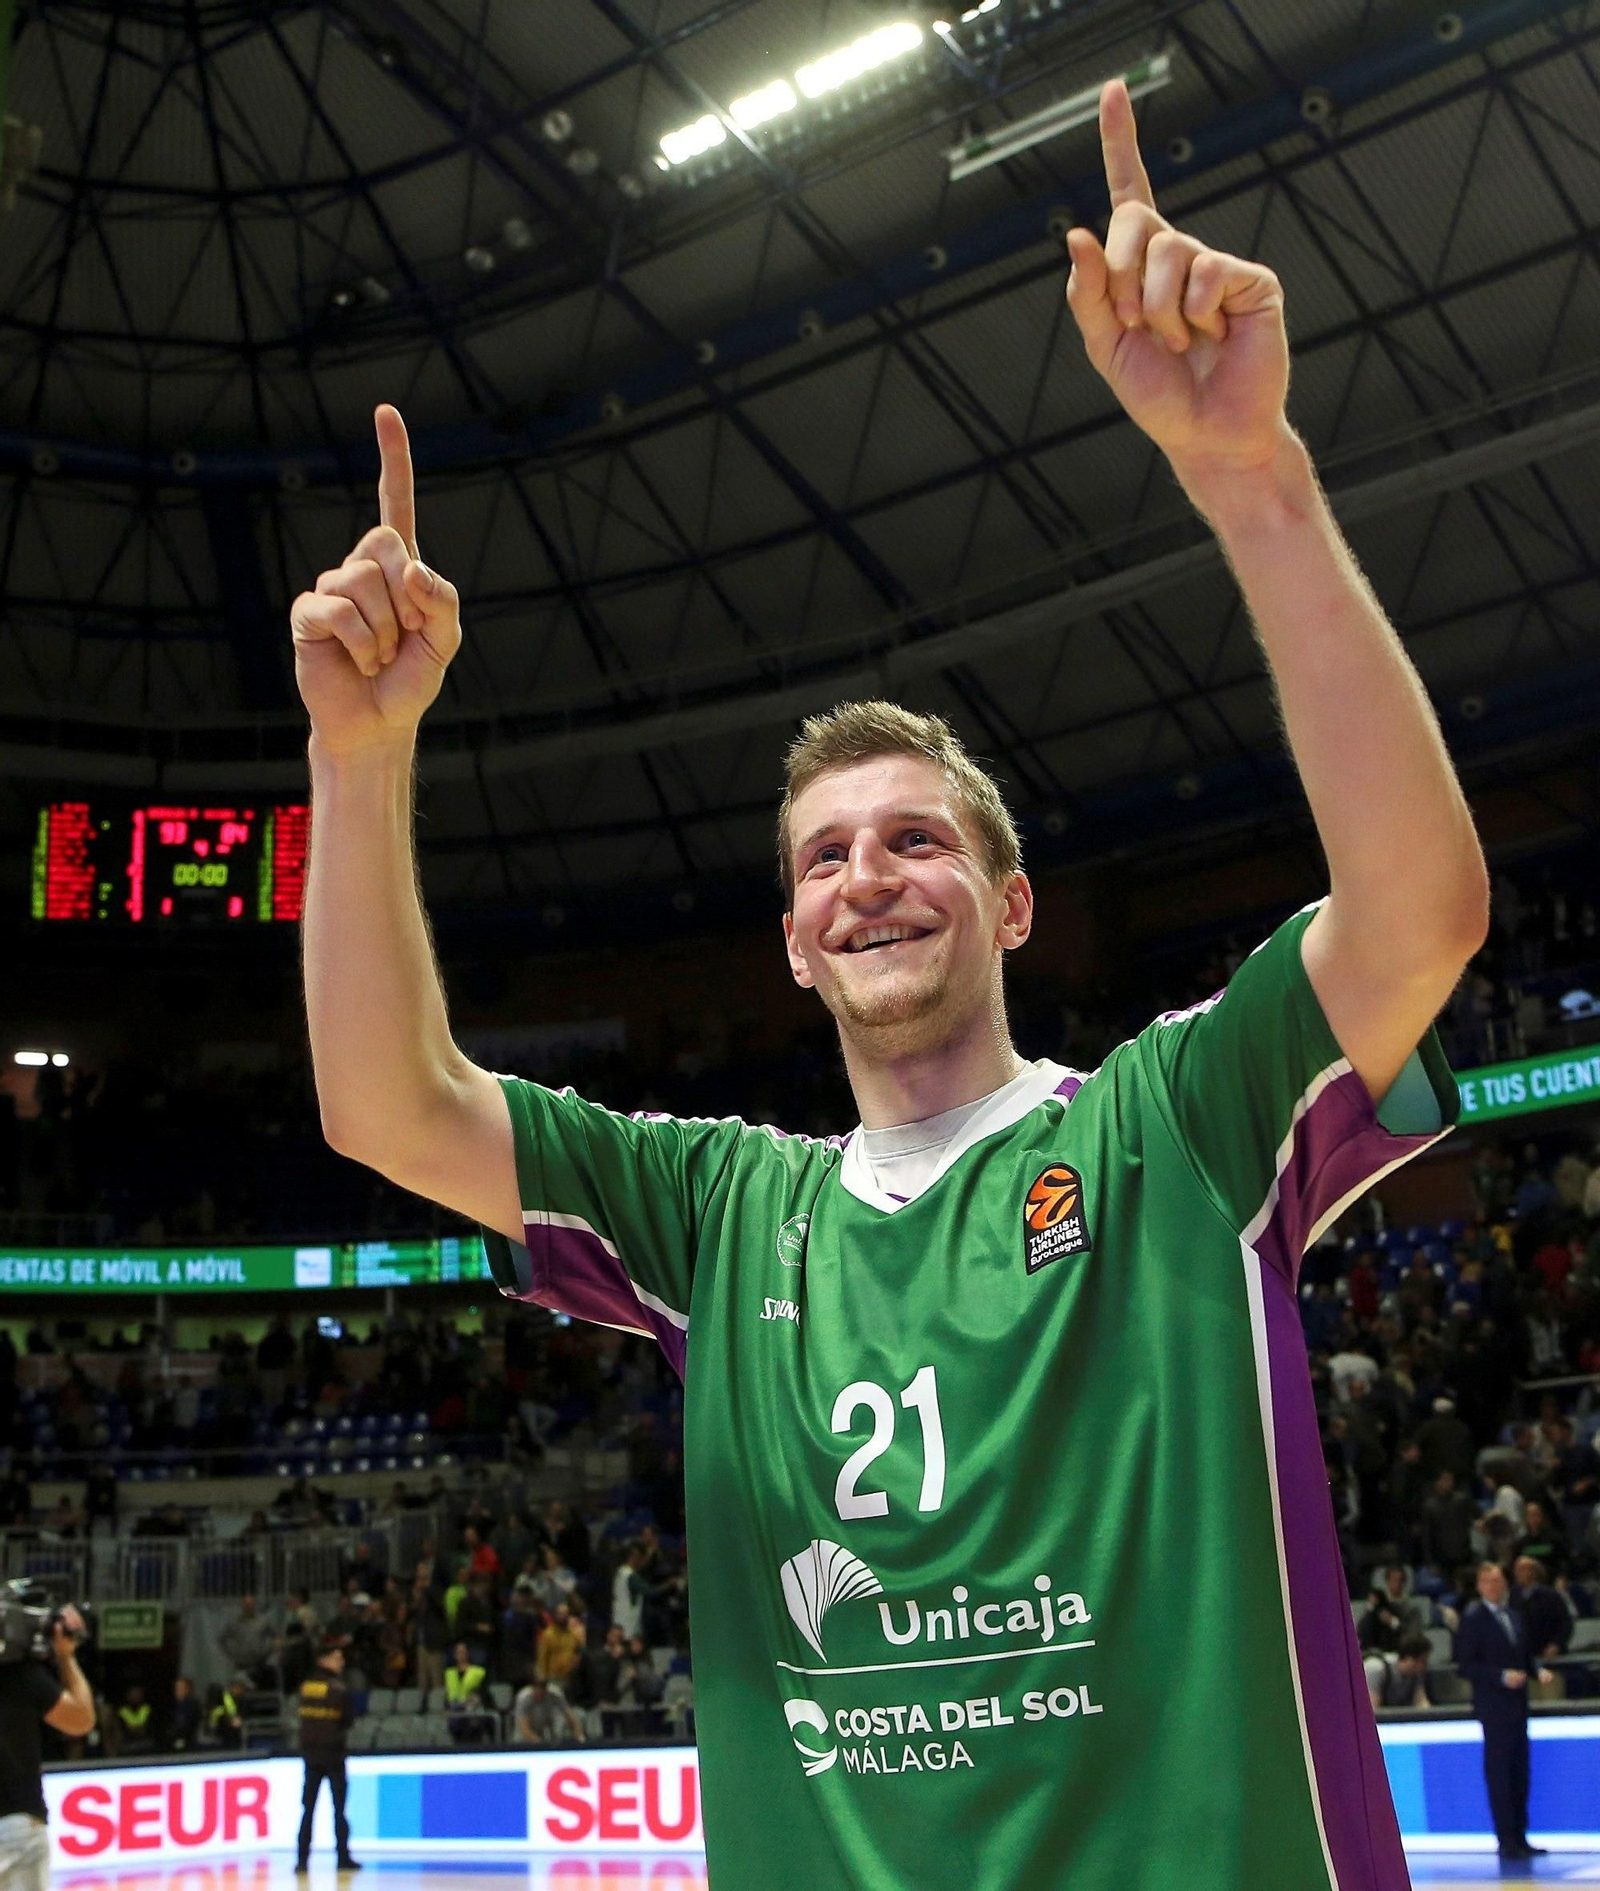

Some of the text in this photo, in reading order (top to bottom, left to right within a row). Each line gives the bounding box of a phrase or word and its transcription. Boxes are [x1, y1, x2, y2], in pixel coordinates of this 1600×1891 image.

[1461, 1081, 1478, 1112] E
[1482, 1073, 1527, 1107] TUS
[1029, 1216, 1080, 1247] TURKISH
[1030, 1227, 1082, 1257] AIRLINES
[70, 1258, 95, 1284] DE
[101, 1253, 161, 1284] MÓVIL
[167, 1259, 181, 1284] A
[185, 1252, 246, 1284] MÓVIL
[831, 1365, 946, 1521] 21
[877, 1574, 1092, 1645] Unicaja
[834, 1685, 1104, 1738] COSTA DEL SOL
[842, 1739, 975, 1775] MÁLAGA
[58, 1776, 270, 1857] SEUR
[545, 1767, 696, 1842] SEU
